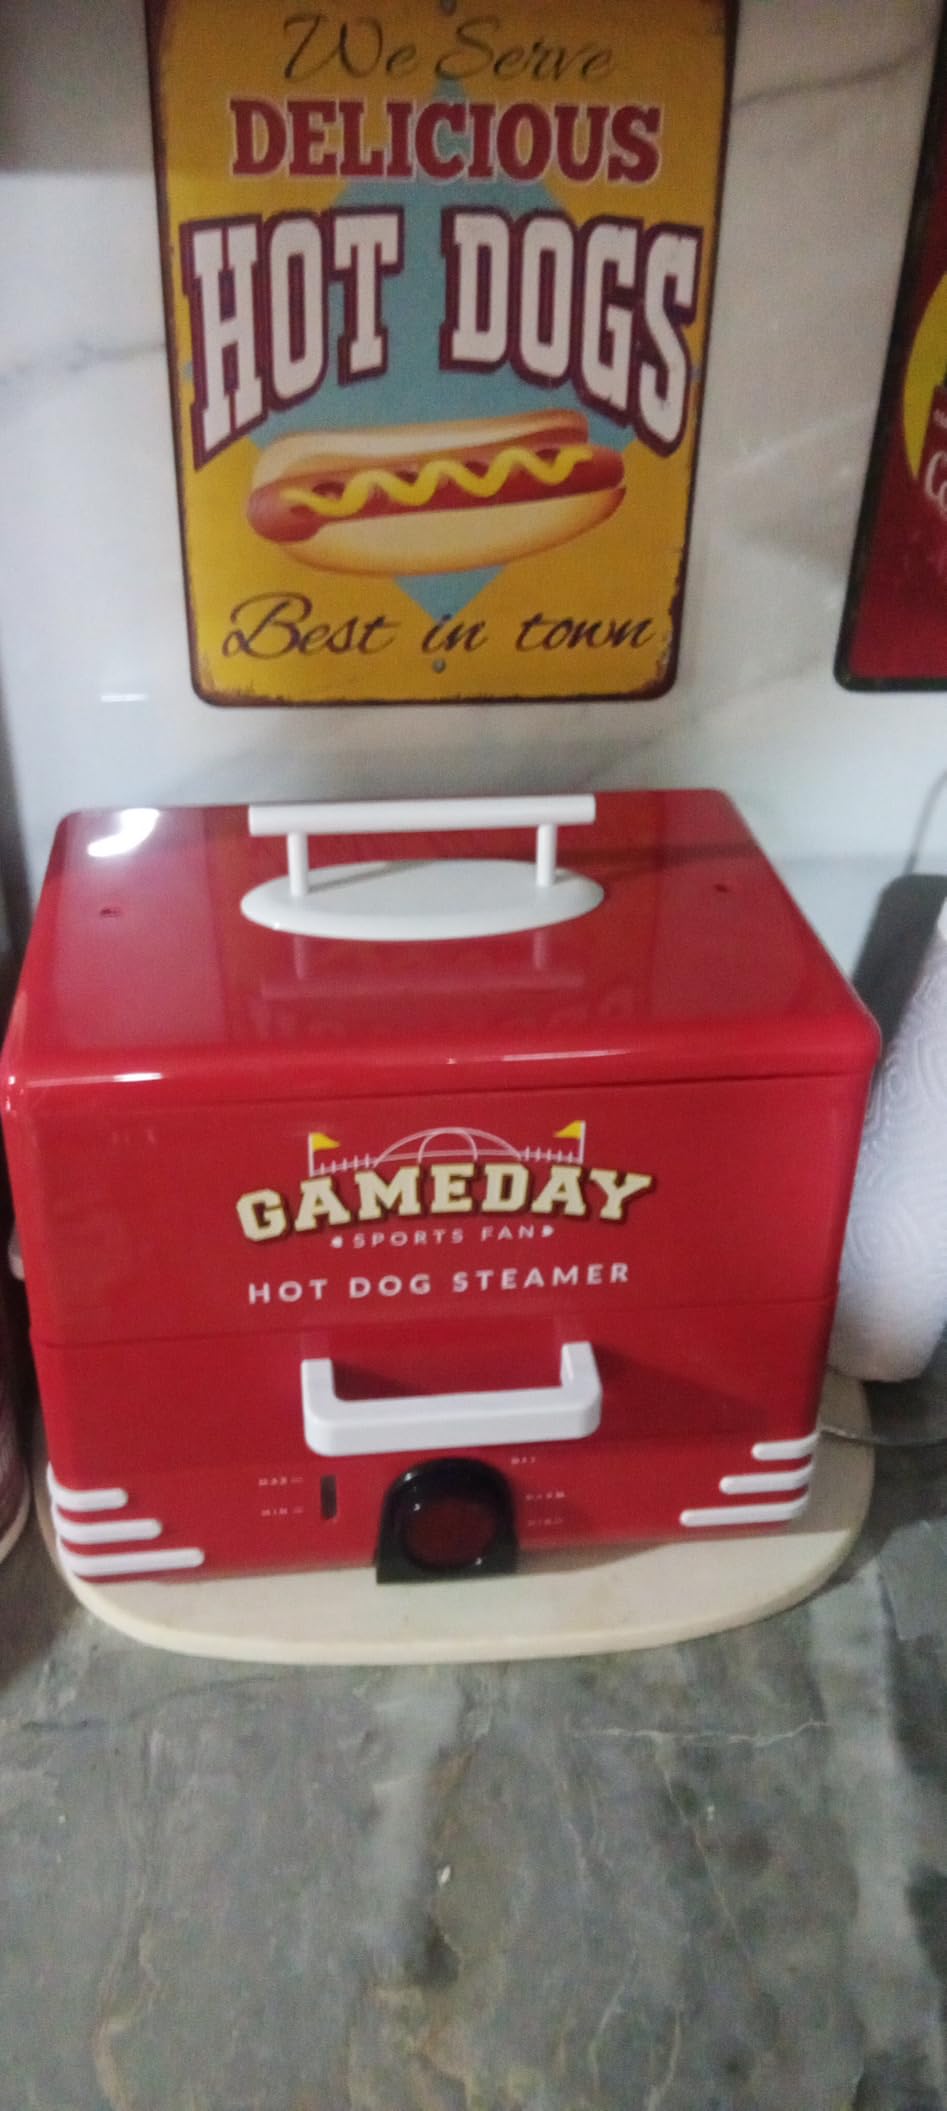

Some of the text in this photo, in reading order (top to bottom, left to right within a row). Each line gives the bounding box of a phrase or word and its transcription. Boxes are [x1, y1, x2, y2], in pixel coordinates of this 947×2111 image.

[283, 13, 619, 82] We Serve
[228, 97, 664, 184] DELICIOUS
[183, 205, 704, 463] HOT DOGS
[221, 591, 656, 660] Best in town
[235, 1162, 654, 1244] GAMEDAY
[352, 1224, 535, 1249] SPORTS FAN
[247, 1262, 631, 1305] HOT DOG STEAMER
